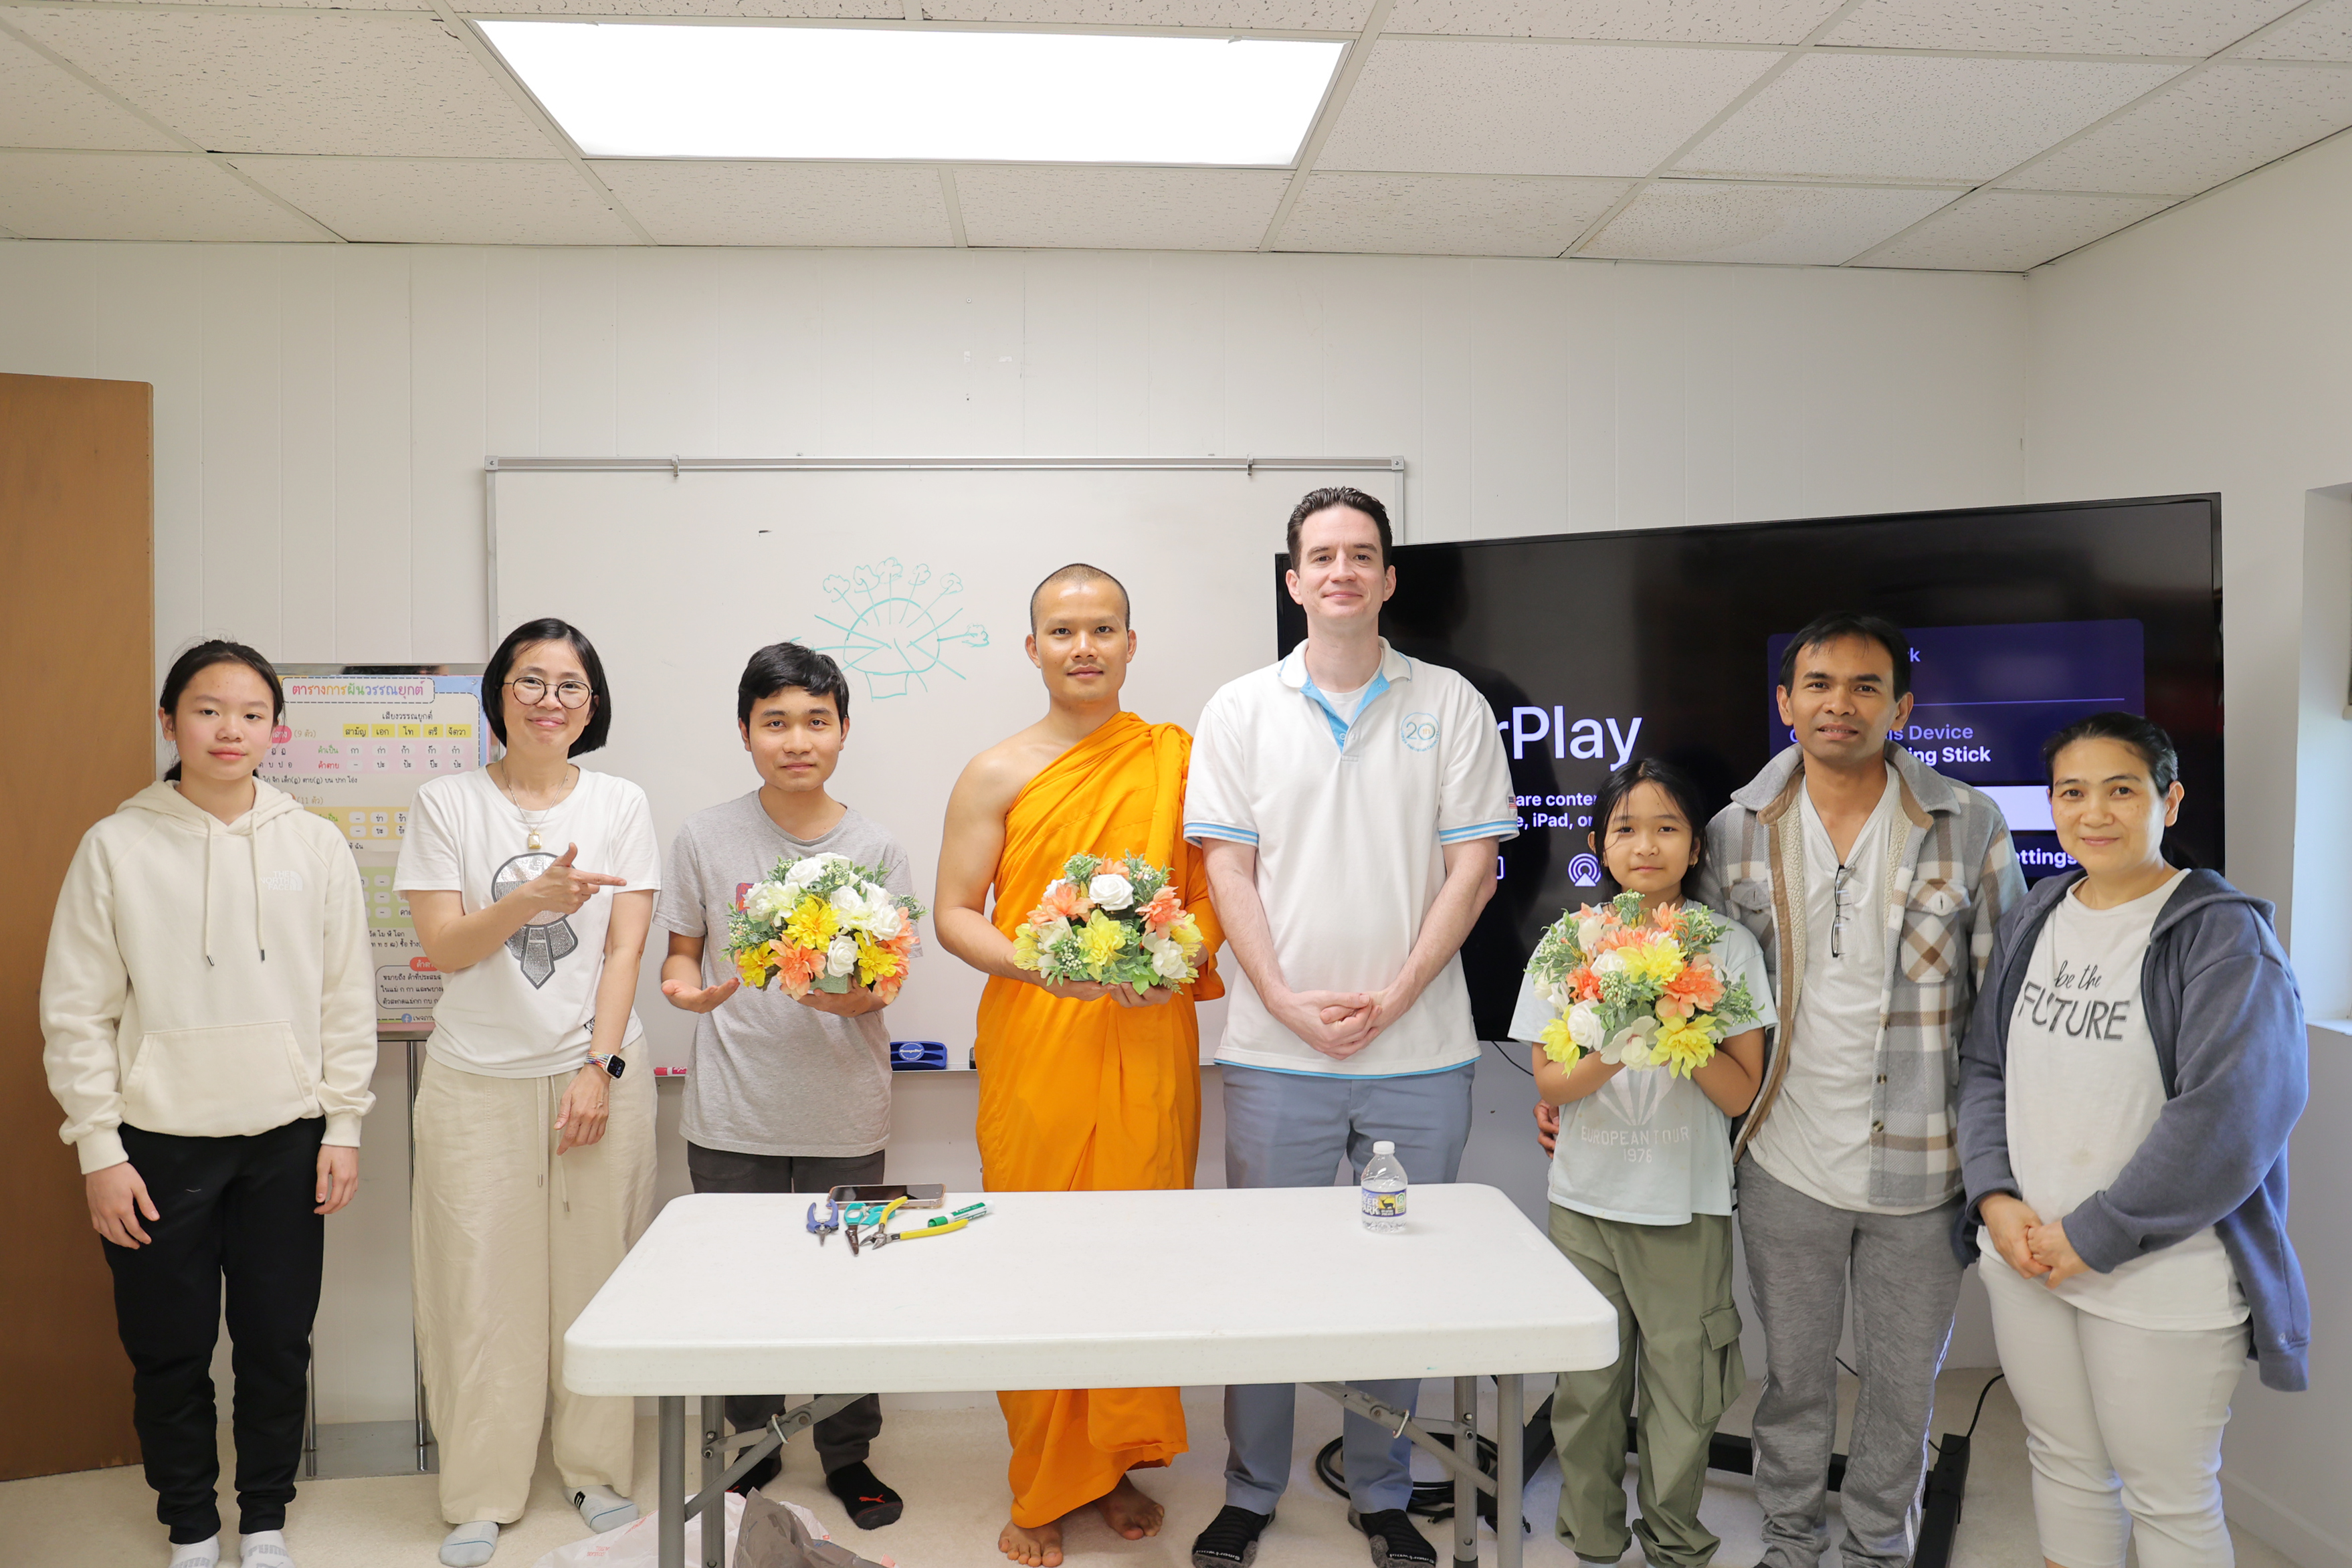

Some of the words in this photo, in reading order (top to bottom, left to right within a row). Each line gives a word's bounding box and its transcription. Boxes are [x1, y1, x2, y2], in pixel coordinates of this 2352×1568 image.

[292, 680, 425, 699] ตารางการผันวรรณยุกต์
[382, 710, 433, 722] เสียงวรรณยุกต์
[345, 726, 366, 737] สามัญ
[403, 726, 413, 736] โท
[428, 726, 437, 736] ตรี
[448, 726, 466, 736] จัตวา
[1497, 704, 1643, 772] Play
[1909, 724, 1974, 740] Device
[318, 745, 338, 754] คำเป็น
[1908, 747, 1937, 766] ing
[1942, 746, 1991, 763] Stick
[1516, 795, 1542, 806] are
[1545, 793, 1597, 806] conte
[1517, 815, 1529, 830] e,
[1533, 812, 1573, 830] iPad,
[2054, 960, 2075, 989] be
[2078, 964, 2102, 991] the
[2018, 981, 2130, 1041] FUTURE
[1581, 1126, 1650, 1146] EUROPEAN
[1654, 1126, 1690, 1145] TOUR
[1624, 1148, 1653, 1163] 1976
